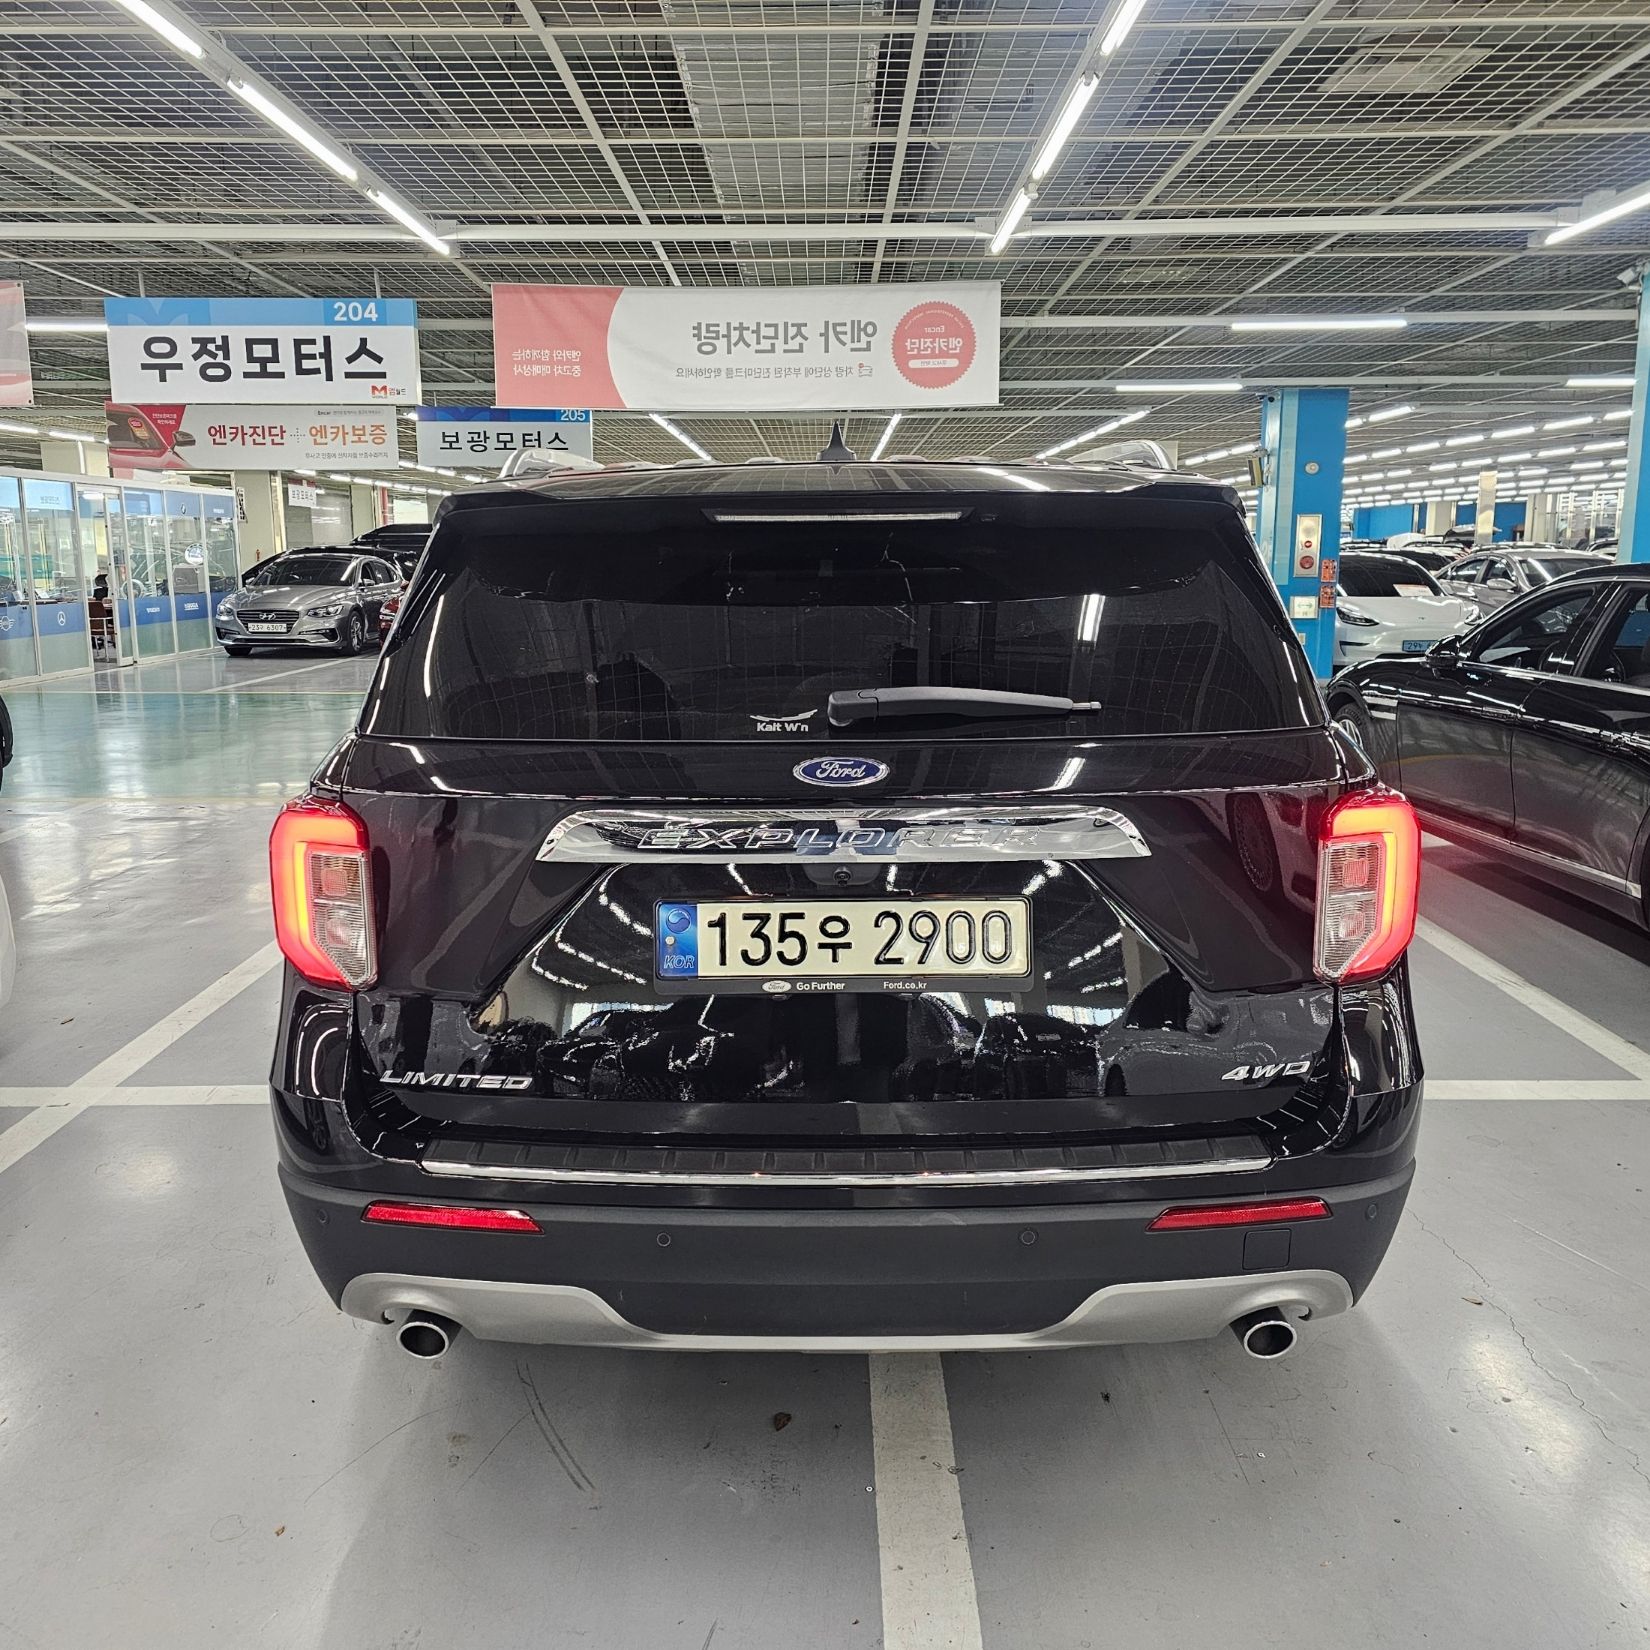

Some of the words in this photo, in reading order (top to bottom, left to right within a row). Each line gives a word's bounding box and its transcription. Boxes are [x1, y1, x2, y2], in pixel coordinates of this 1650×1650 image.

[333, 302, 378, 322] 204
[140, 335, 387, 382] 우정모터스
[560, 409, 586, 421] 205
[207, 424, 287, 446] 엔카진단
[309, 424, 388, 446] 엔카보증
[439, 430, 569, 453] 보광모터스
[815, 760, 866, 778] Ford
[638, 826, 1041, 849] EXPLORER
[707, 912, 853, 966] 135우
[874, 910, 1012, 965] 2900
[664, 955, 695, 969] KOR
[796, 982, 810, 991] Go
[811, 981, 845, 991] Further
[883, 981, 927, 990] Ford.co.kr
[380, 1070, 533, 1090] LIMITED
[1221, 1061, 1311, 1081] 4WD
